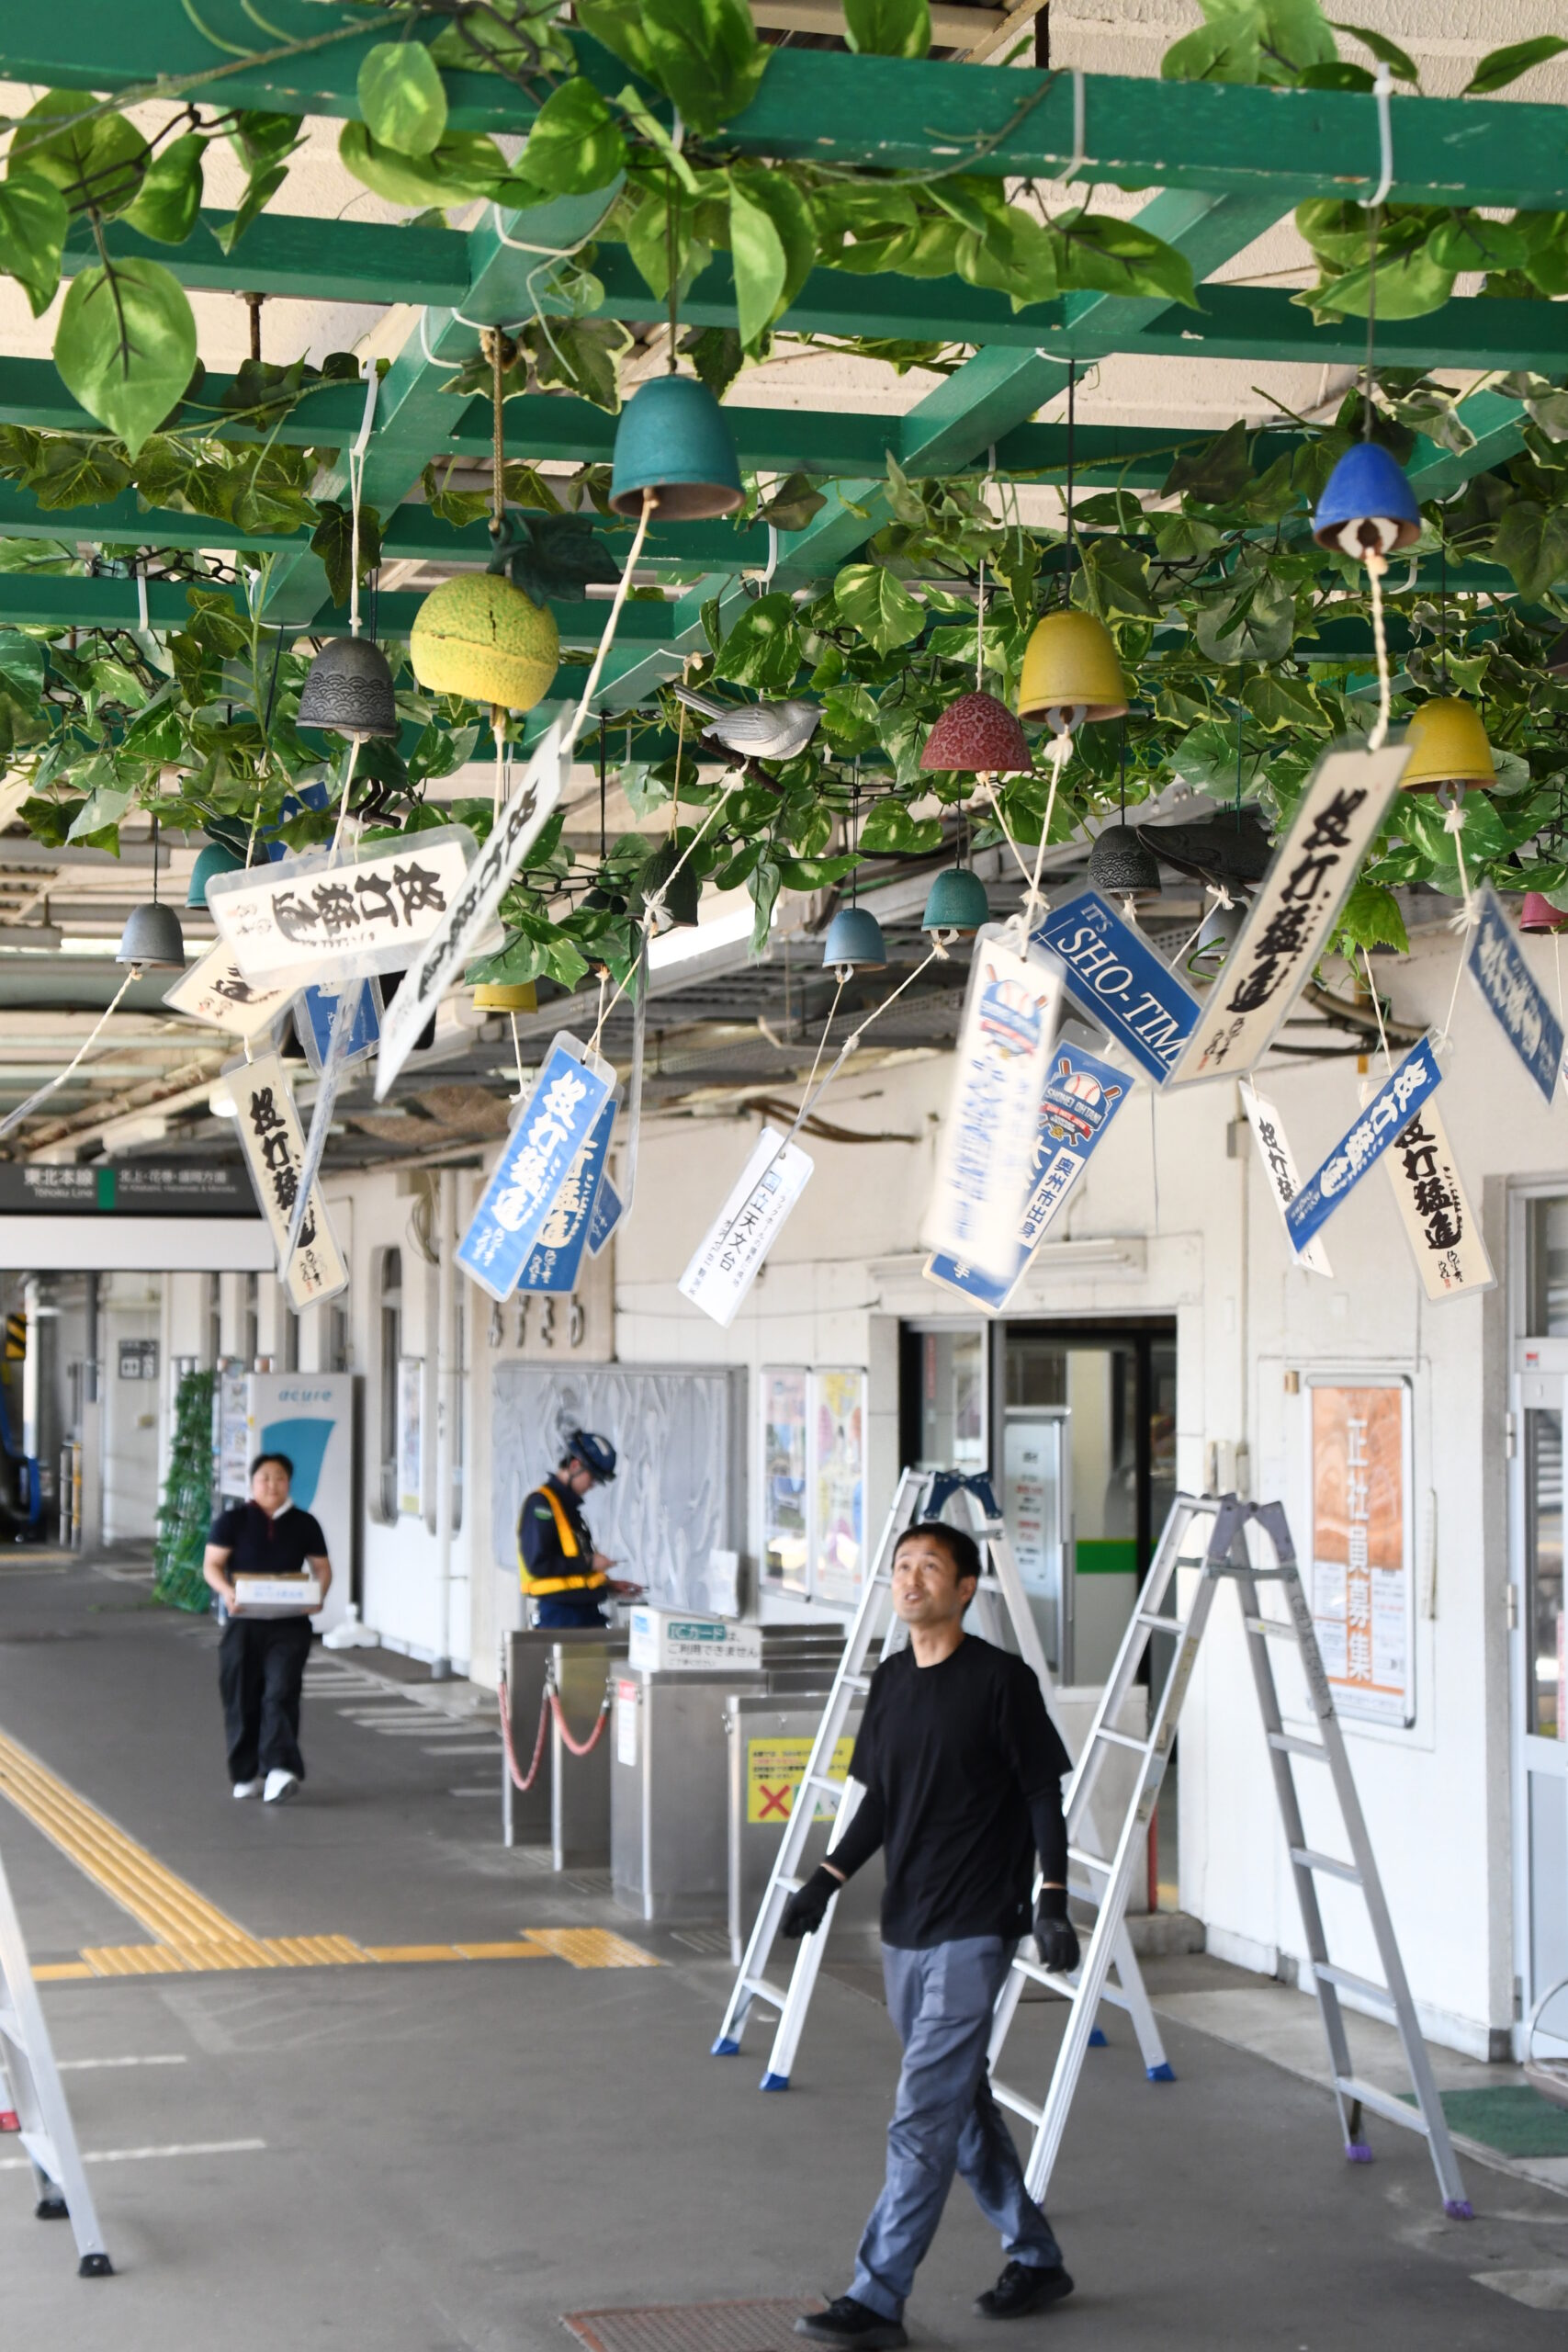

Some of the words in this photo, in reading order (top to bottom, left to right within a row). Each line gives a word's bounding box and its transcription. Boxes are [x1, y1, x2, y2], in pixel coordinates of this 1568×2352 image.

[1080, 902, 1113, 933] IT'S
[1057, 927, 1185, 1068] SHO-TIM
[719, 1170, 782, 1272] 国立天文台
[1019, 1157, 1075, 1238] 奥州市出身
[278, 1387, 333, 1403] acure
[1347, 1418, 1372, 1682] 正社員募集
